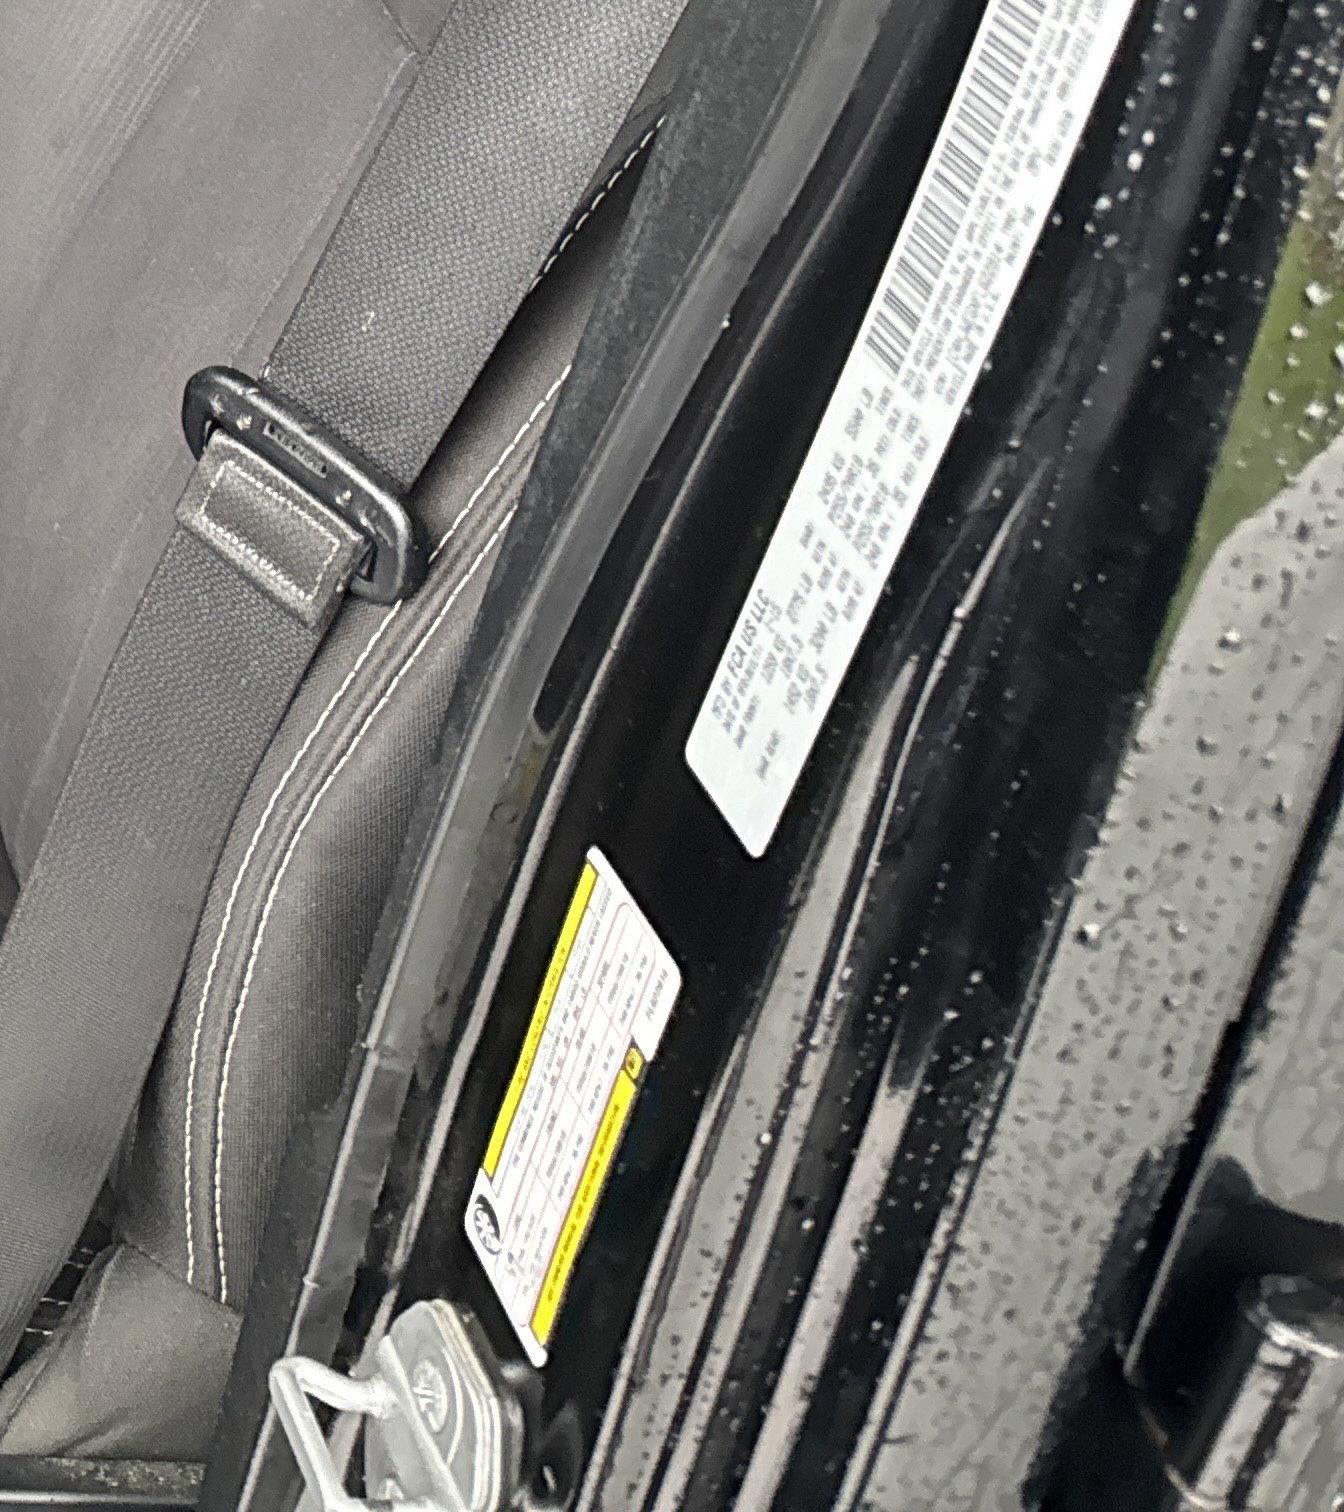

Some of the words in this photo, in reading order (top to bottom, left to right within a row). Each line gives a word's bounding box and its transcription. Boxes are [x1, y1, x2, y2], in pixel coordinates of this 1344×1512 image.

[748, 585, 771, 625] LLC
[739, 617, 758, 649] US
[725, 641, 747, 680] FCA
